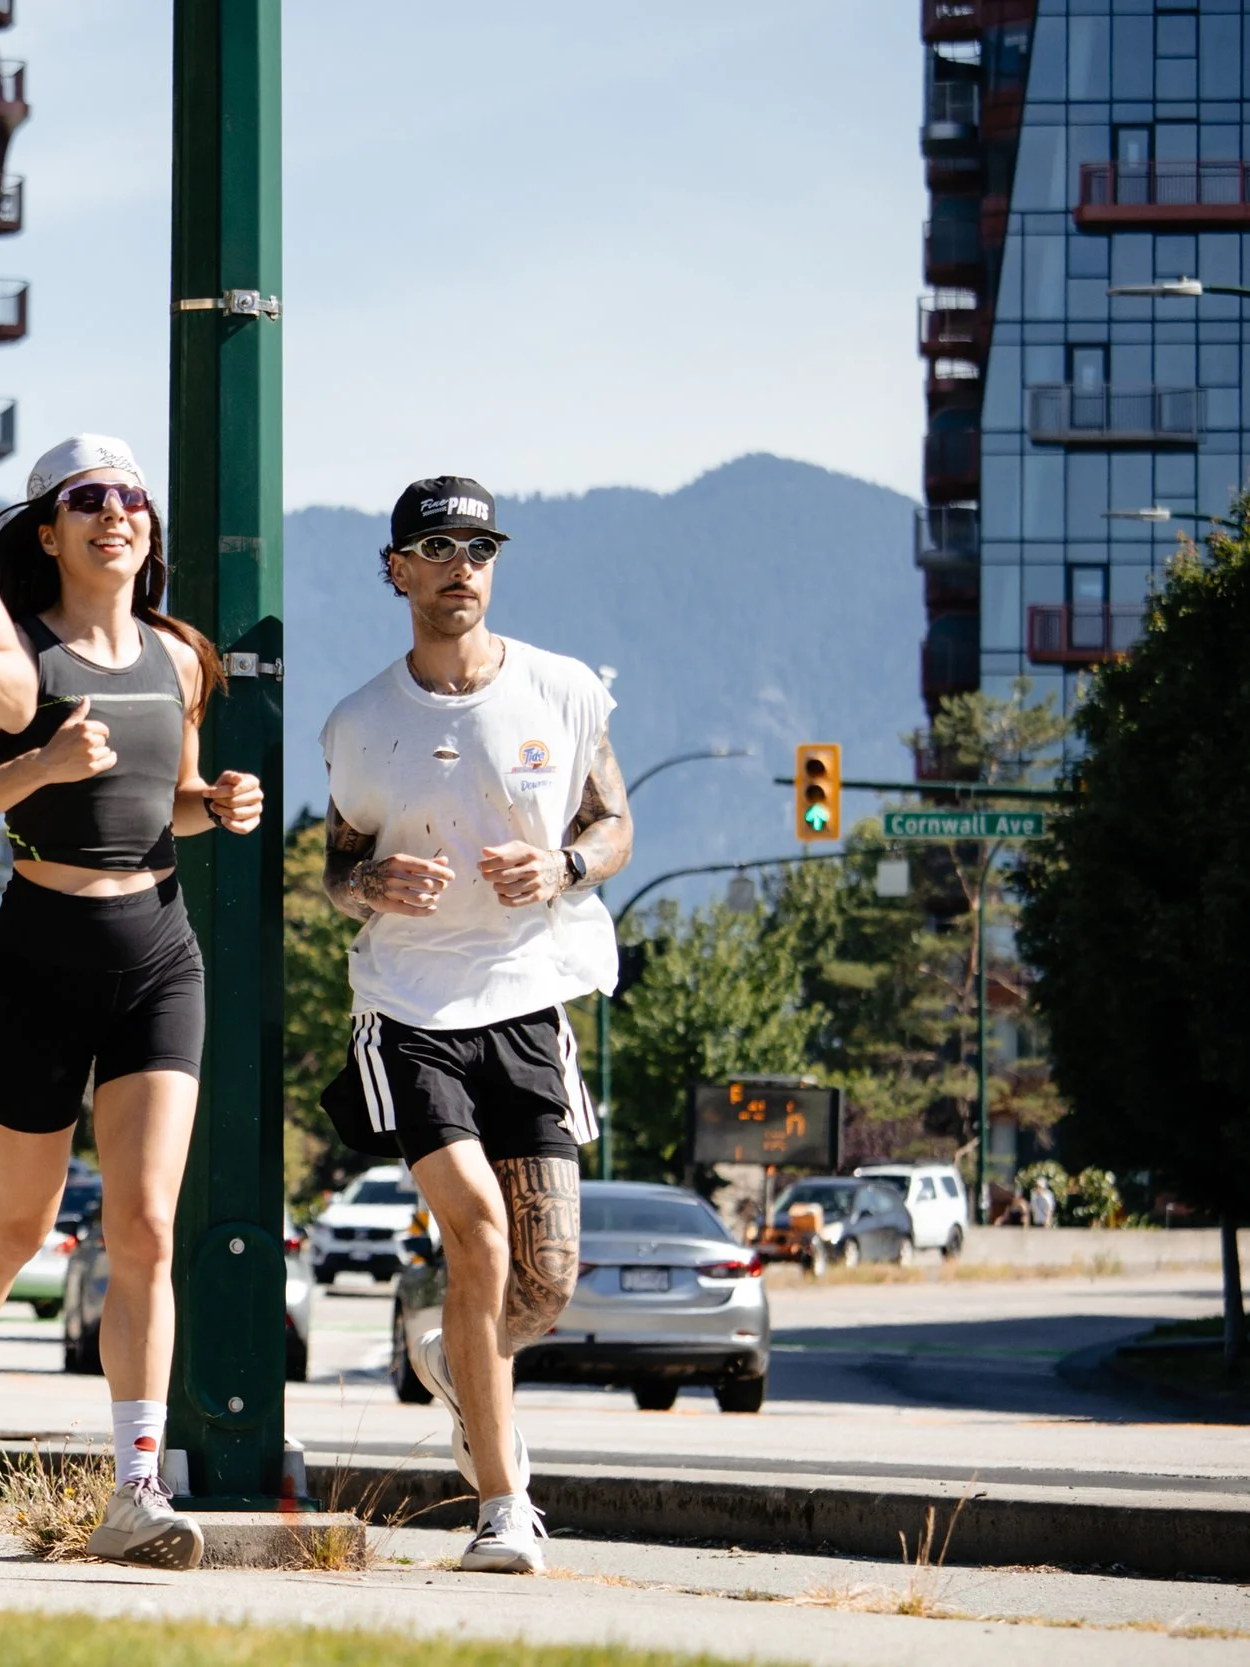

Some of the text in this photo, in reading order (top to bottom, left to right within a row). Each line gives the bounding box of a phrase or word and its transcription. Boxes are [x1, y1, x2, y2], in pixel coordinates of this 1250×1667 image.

[447, 496, 490, 521] PARTS
[523, 747, 546, 765] Tide
[890, 814, 1035, 836] Cornwall Ave
